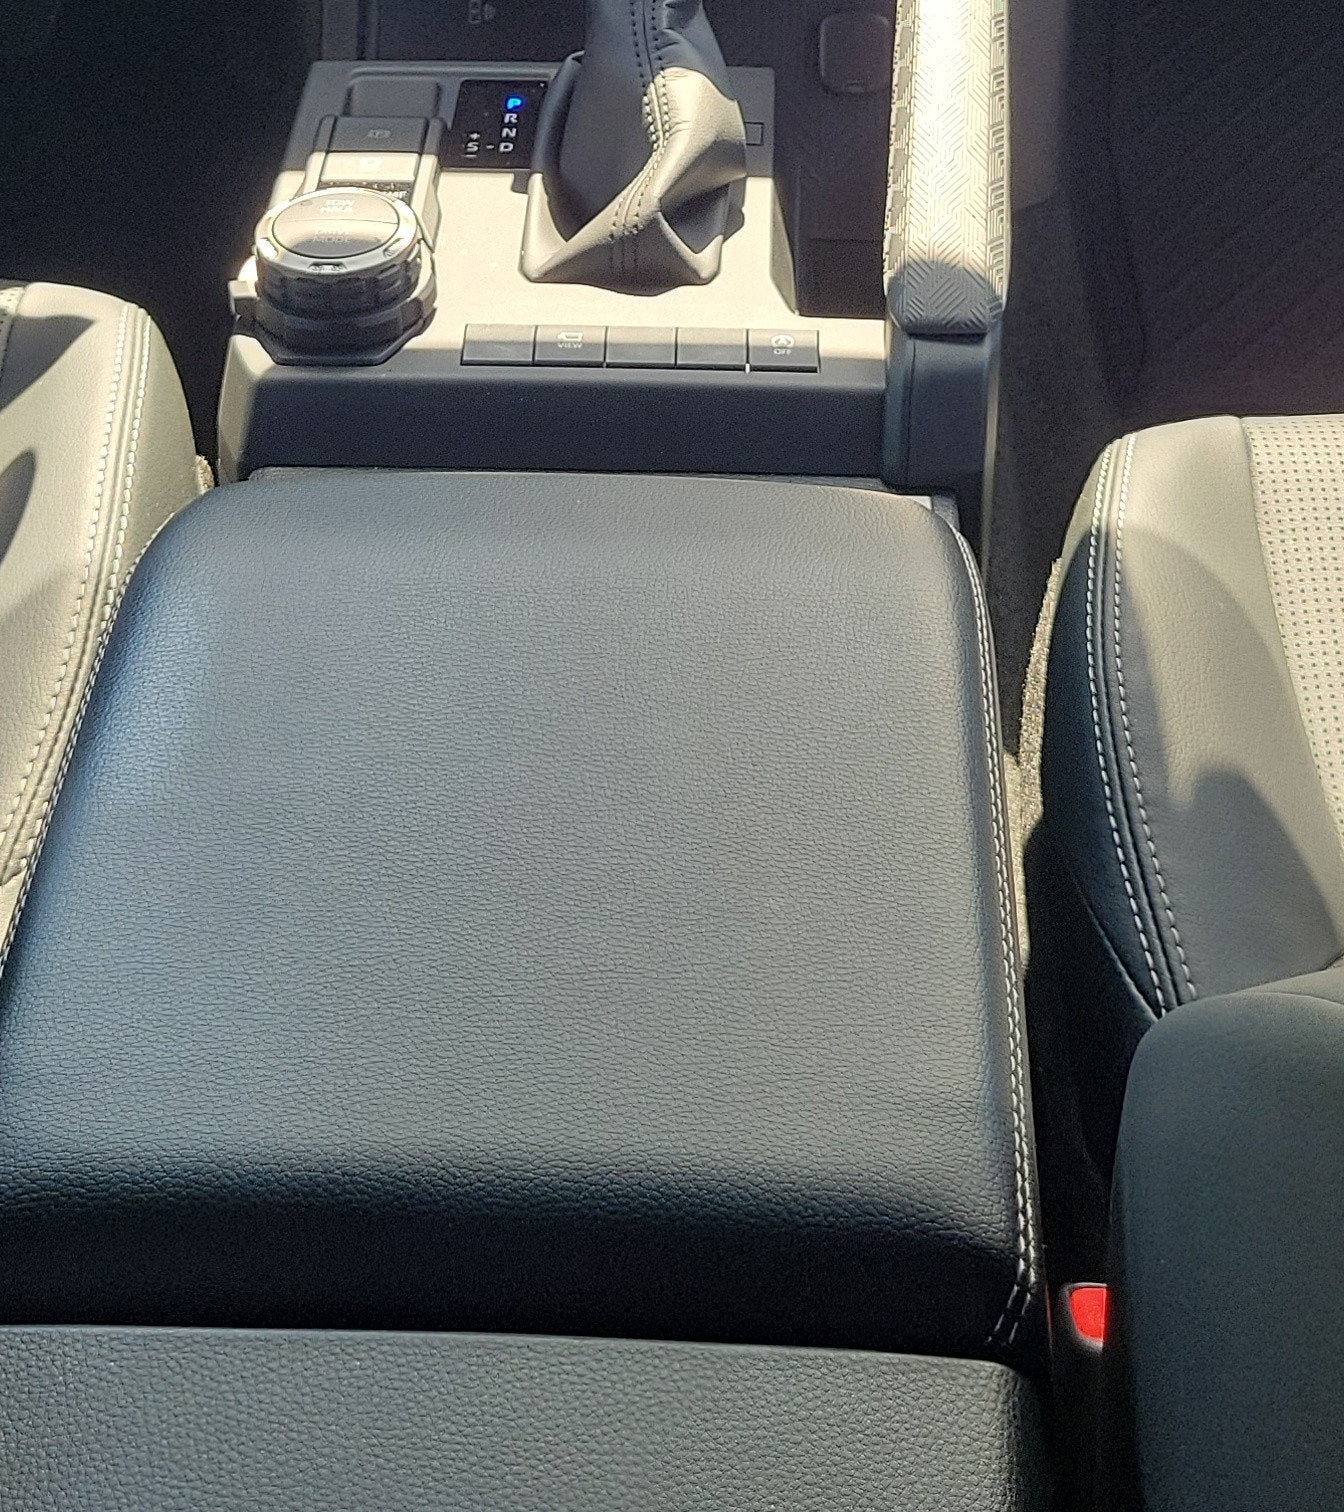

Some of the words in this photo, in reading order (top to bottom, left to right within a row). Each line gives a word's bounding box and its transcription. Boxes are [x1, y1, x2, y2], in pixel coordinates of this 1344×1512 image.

[505, 96, 524, 111] P
[503, 112, 519, 124] R
[501, 126, 517, 139] N
[498, 141, 515, 153] D
[557, 341, 583, 349] VIEW
[773, 348, 793, 356] OFF
